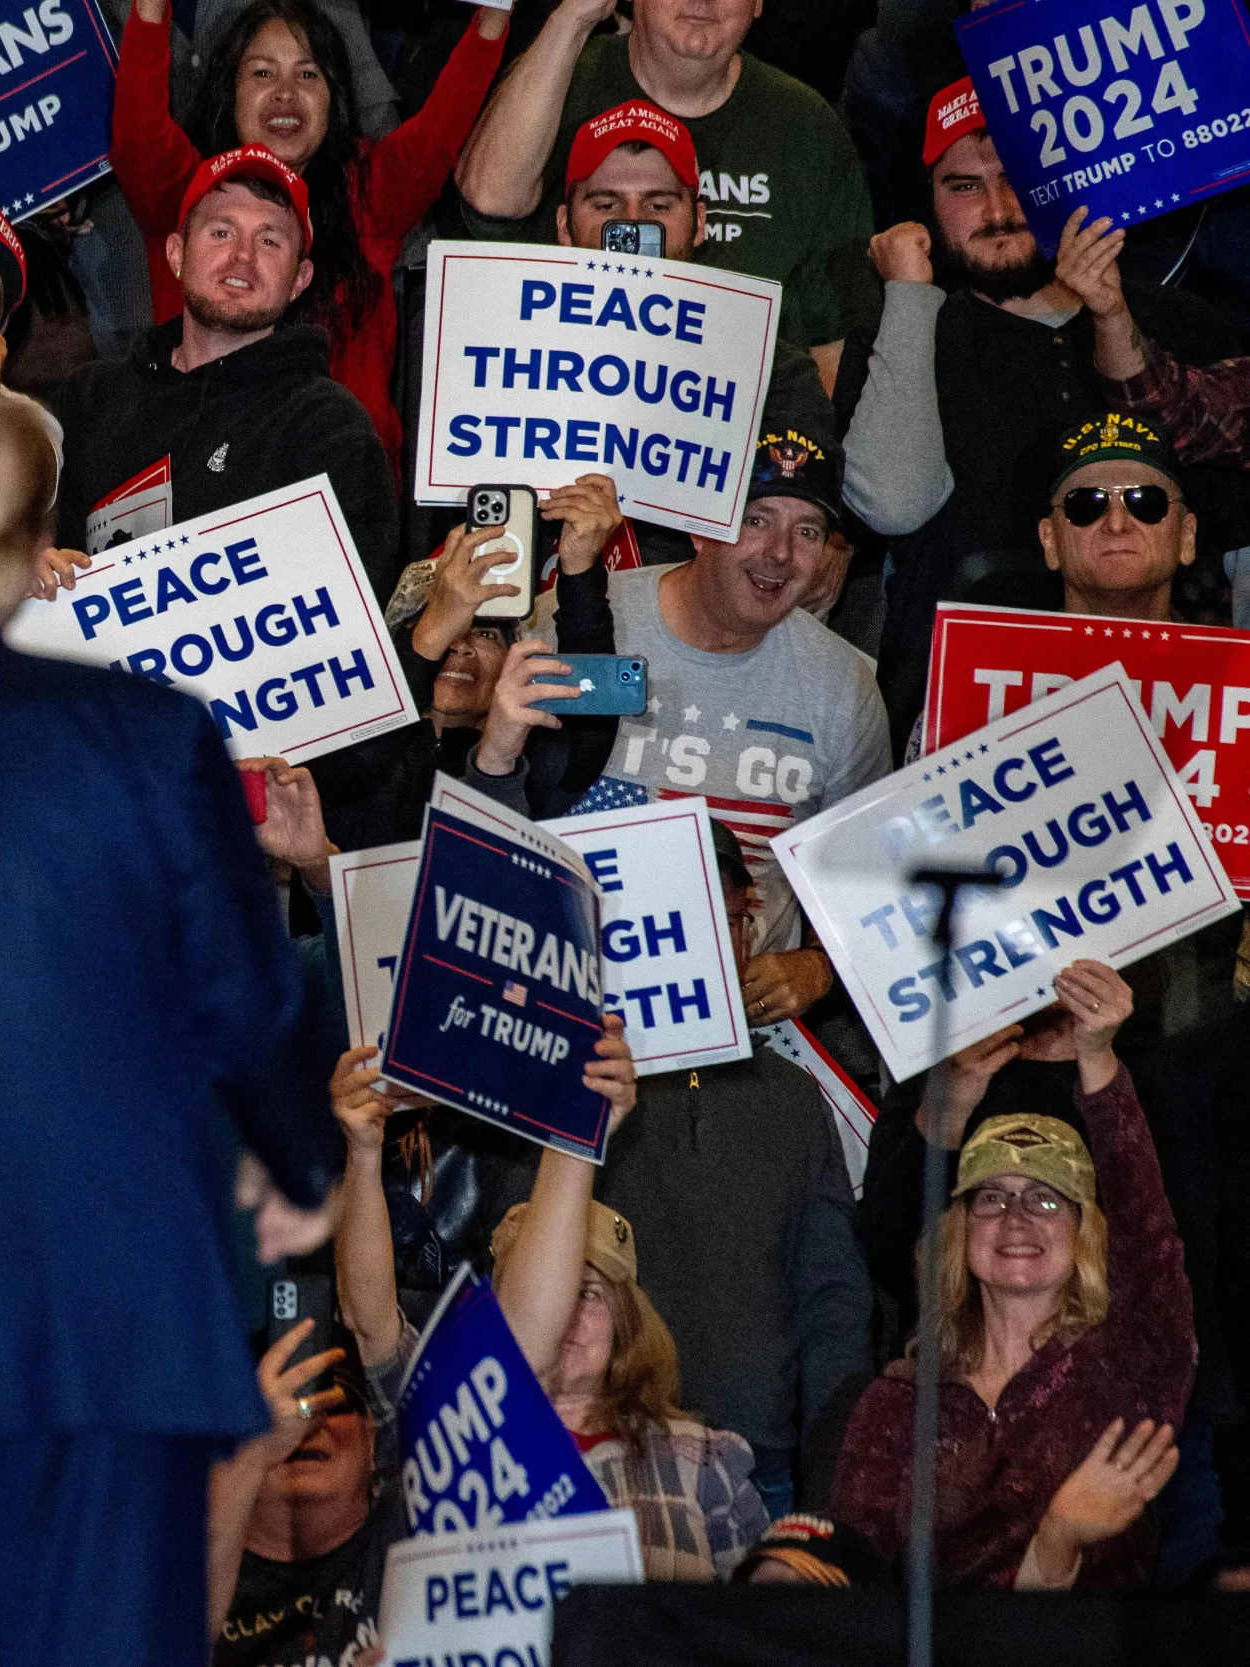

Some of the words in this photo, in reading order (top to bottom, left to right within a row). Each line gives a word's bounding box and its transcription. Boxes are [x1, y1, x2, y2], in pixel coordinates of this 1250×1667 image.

[988, 0, 1205, 114] TRUMP
[590, 110, 623, 130] MAKE
[628, 107, 679, 133] AMERICA
[594, 119, 634, 139] GREAT
[640, 120, 676, 142] AGAIN
[938, 93, 968, 122] MAKE
[942, 102, 980, 130] GREAT
[1030, 59, 1199, 168] 2024
[1029, 180, 1060, 207] TEXT
[1062, 152, 1136, 194] TRUMP
[1141, 138, 1175, 163] TO
[520, 280, 706, 345] PEACE
[464, 346, 736, 422] THROUGH
[446, 414, 732, 493] STRENGTH
[787, 429, 825, 460] NAVY
[1107, 413, 1159, 442] NAVY
[71, 537, 269, 641] PEACE
[109, 586, 340, 686] ROUGH
[209, 648, 376, 741] NGTH
[434, 885, 601, 1006] VETERANS
[439, 995, 476, 1032] for
[480, 1004, 570, 1066] TRUMP
[402, 1355, 508, 1527] RUMP
